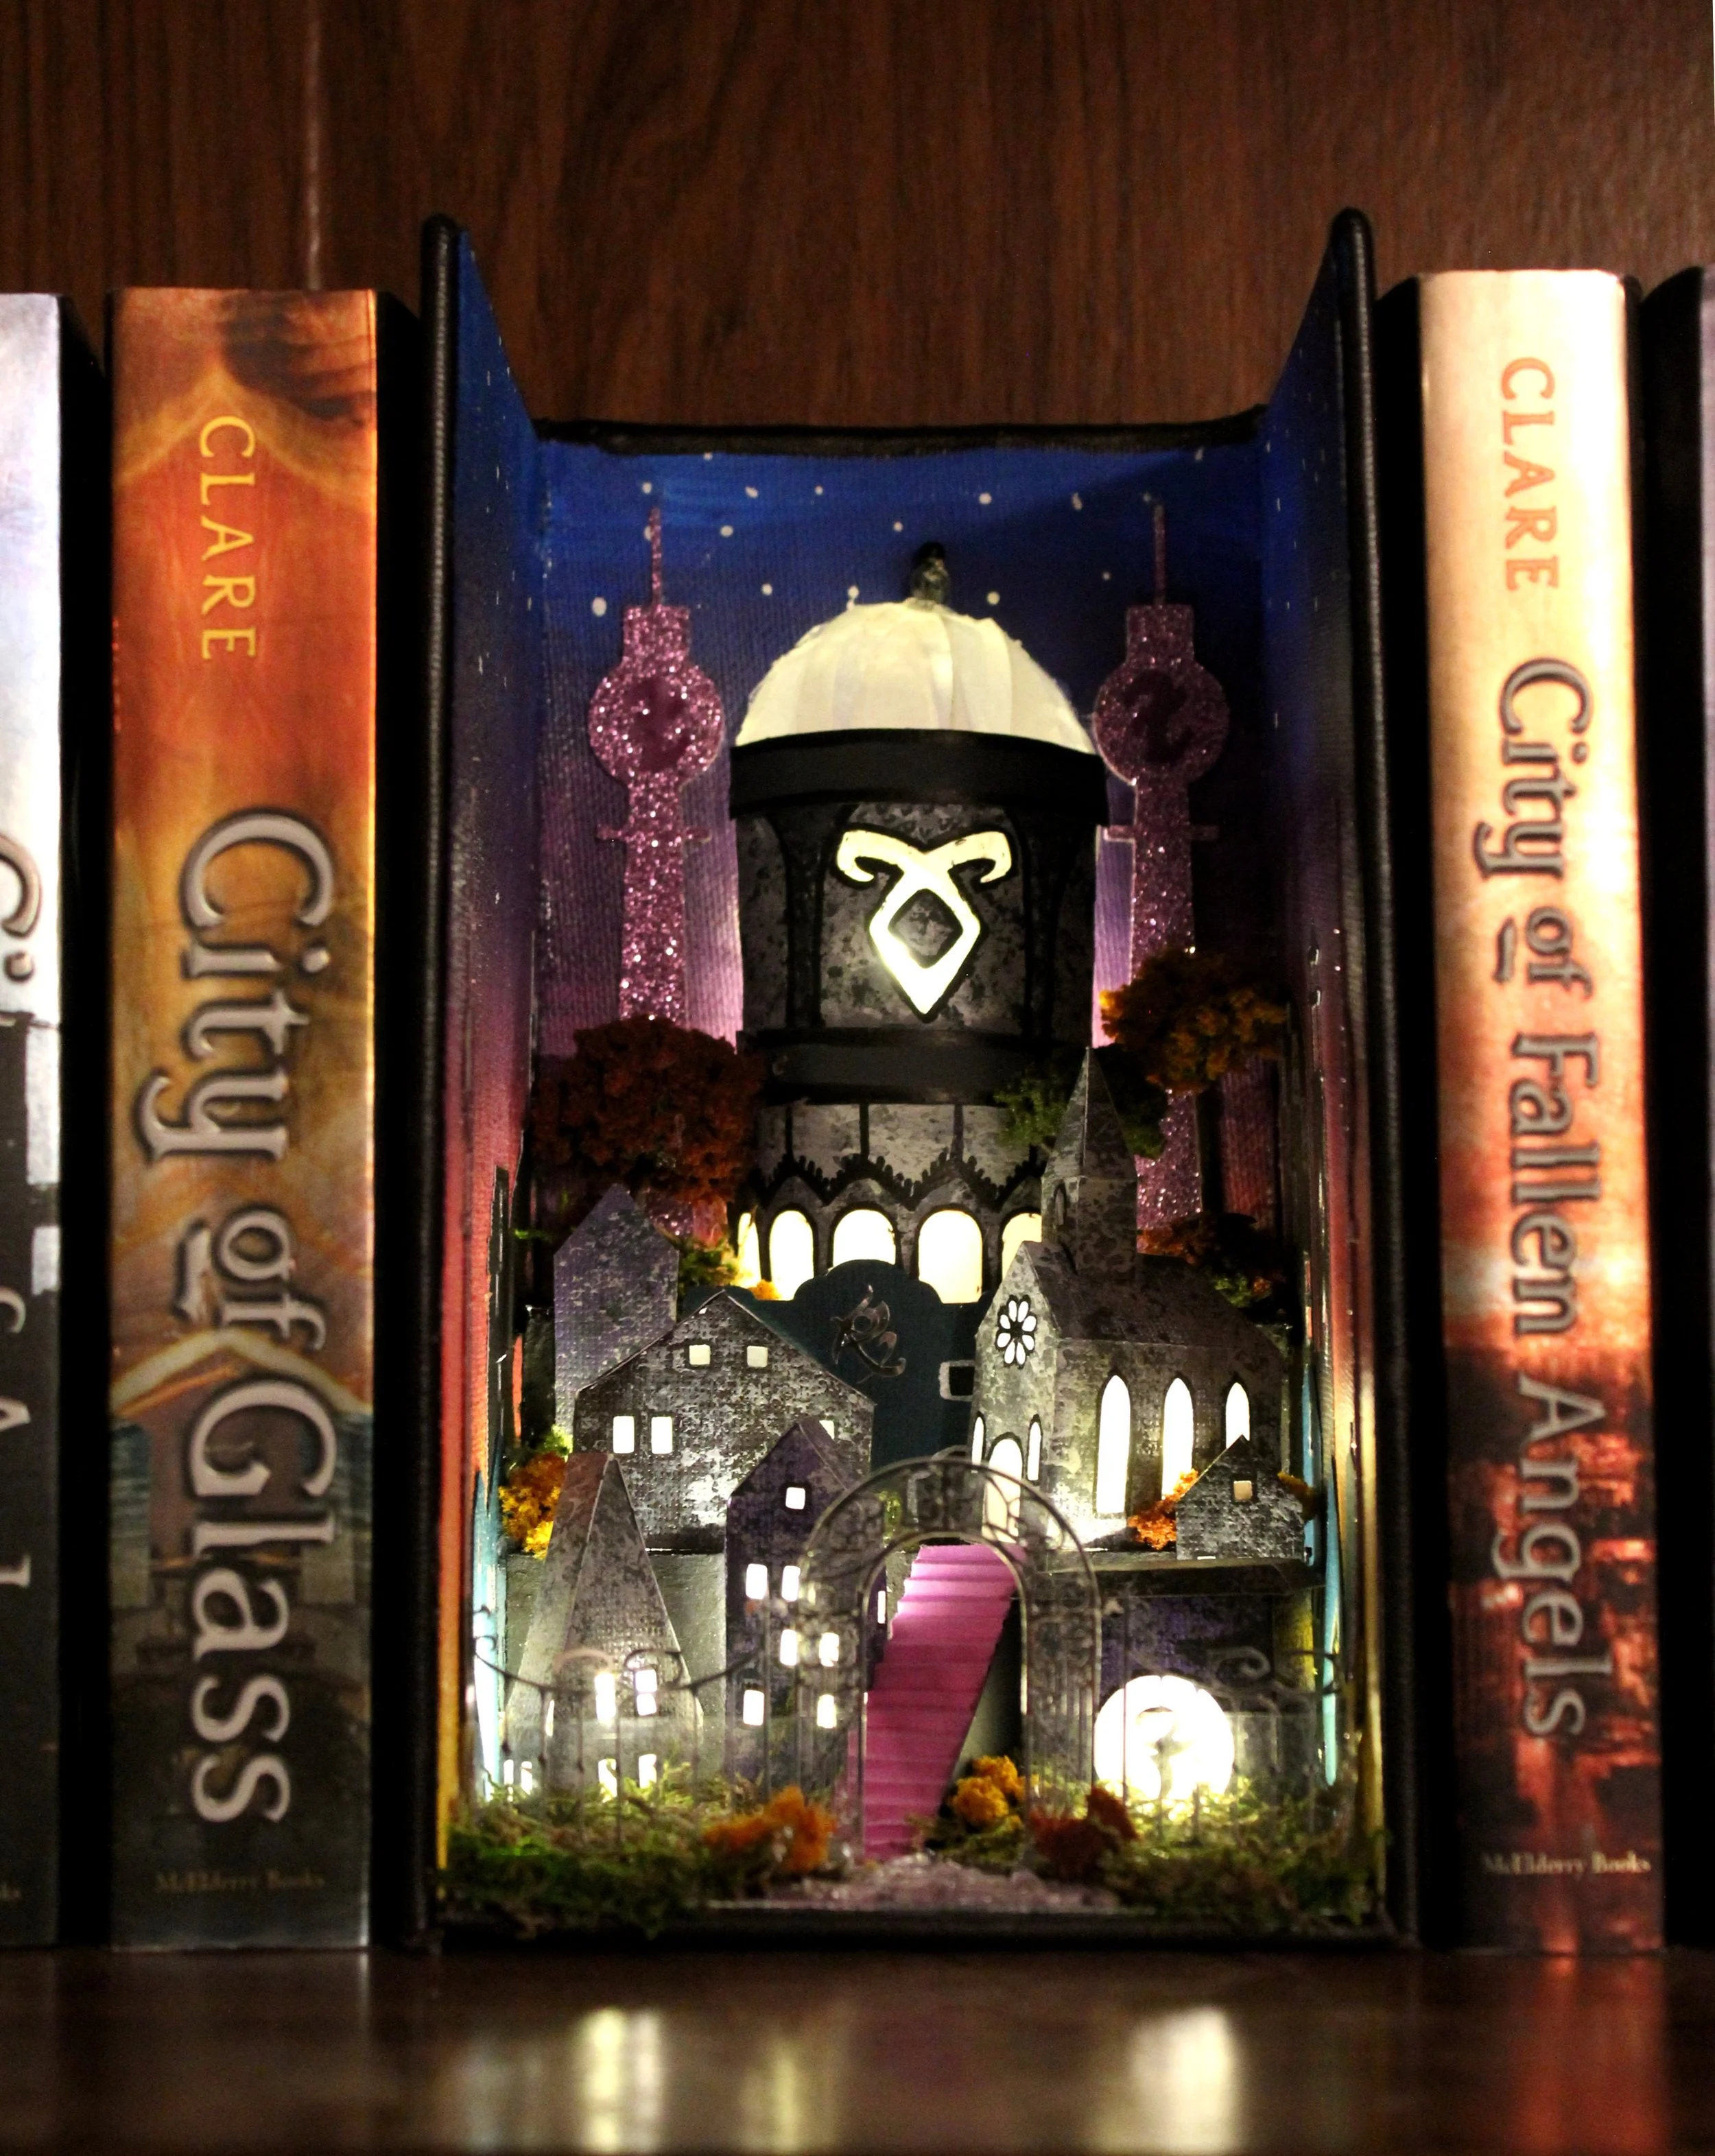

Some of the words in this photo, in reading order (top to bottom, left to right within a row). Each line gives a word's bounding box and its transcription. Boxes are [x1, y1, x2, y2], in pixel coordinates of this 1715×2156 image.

[200, 415, 257, 660] CLARE
[1501, 357, 1559, 591] CLARE
[1473, 657, 1594, 879] City
[139, 811, 333, 1160] City
[1526, 905, 1593, 999] of
[213, 1206, 326, 1350] of
[1509, 1032, 1600, 1338] Fallen
[191, 1380, 338, 1823] Glass
[1491, 1373, 1613, 1738] Angels
